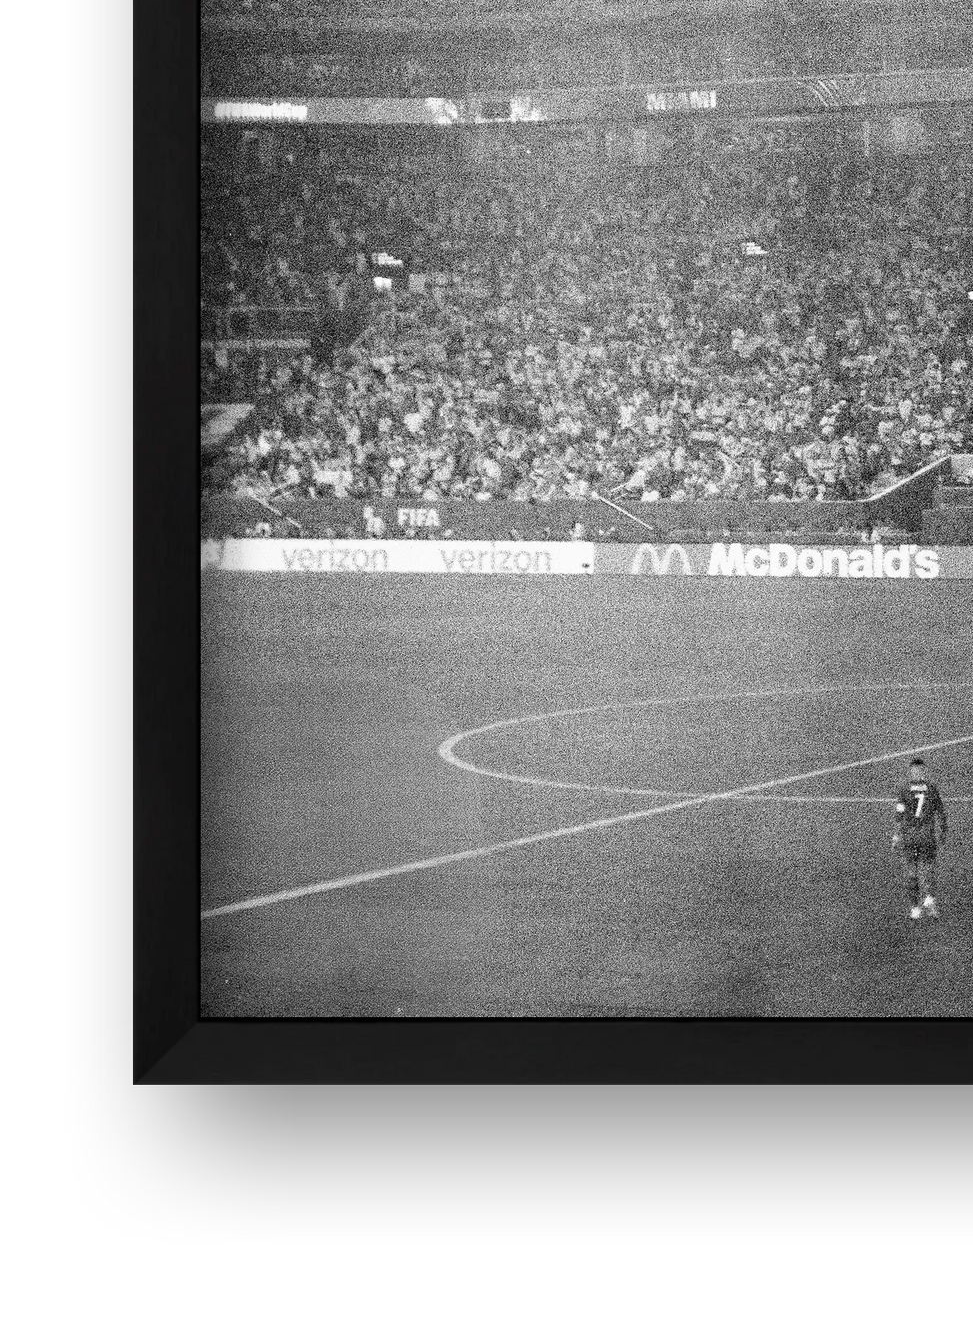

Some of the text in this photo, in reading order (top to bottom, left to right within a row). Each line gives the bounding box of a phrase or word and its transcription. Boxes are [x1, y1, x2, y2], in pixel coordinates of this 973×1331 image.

[398, 508, 440, 527] FIFA
[282, 546, 552, 572] verizon verizon
[707, 542, 939, 578] McDonald's
[915, 793, 925, 817] 7
